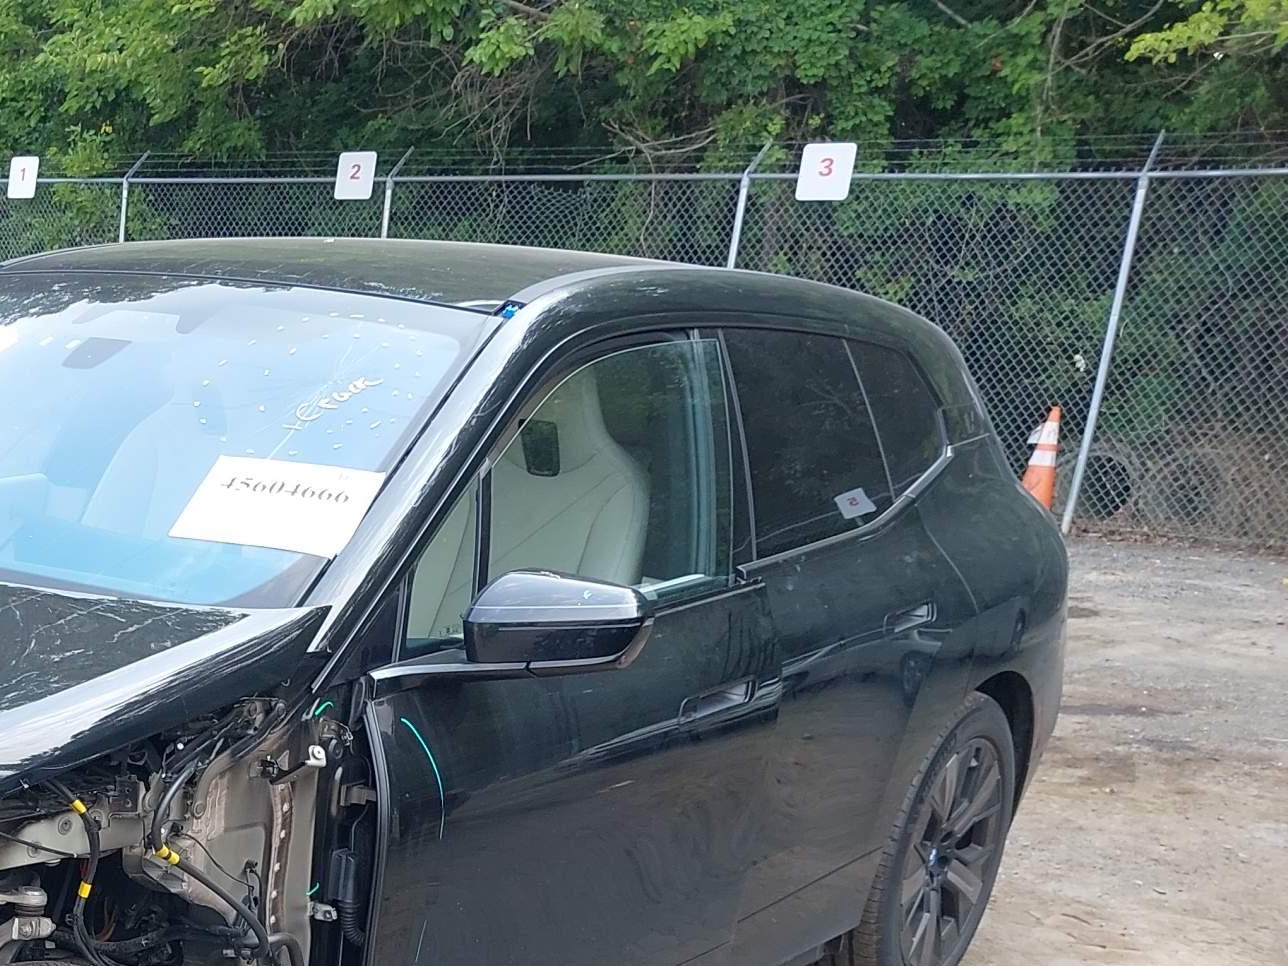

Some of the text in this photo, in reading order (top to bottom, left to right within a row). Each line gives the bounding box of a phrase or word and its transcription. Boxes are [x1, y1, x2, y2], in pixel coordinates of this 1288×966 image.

[20, 167, 26, 181] 1
[349, 163, 361, 180] 2
[818, 157, 834, 177] 3
[220, 475, 350, 504] 45604666
